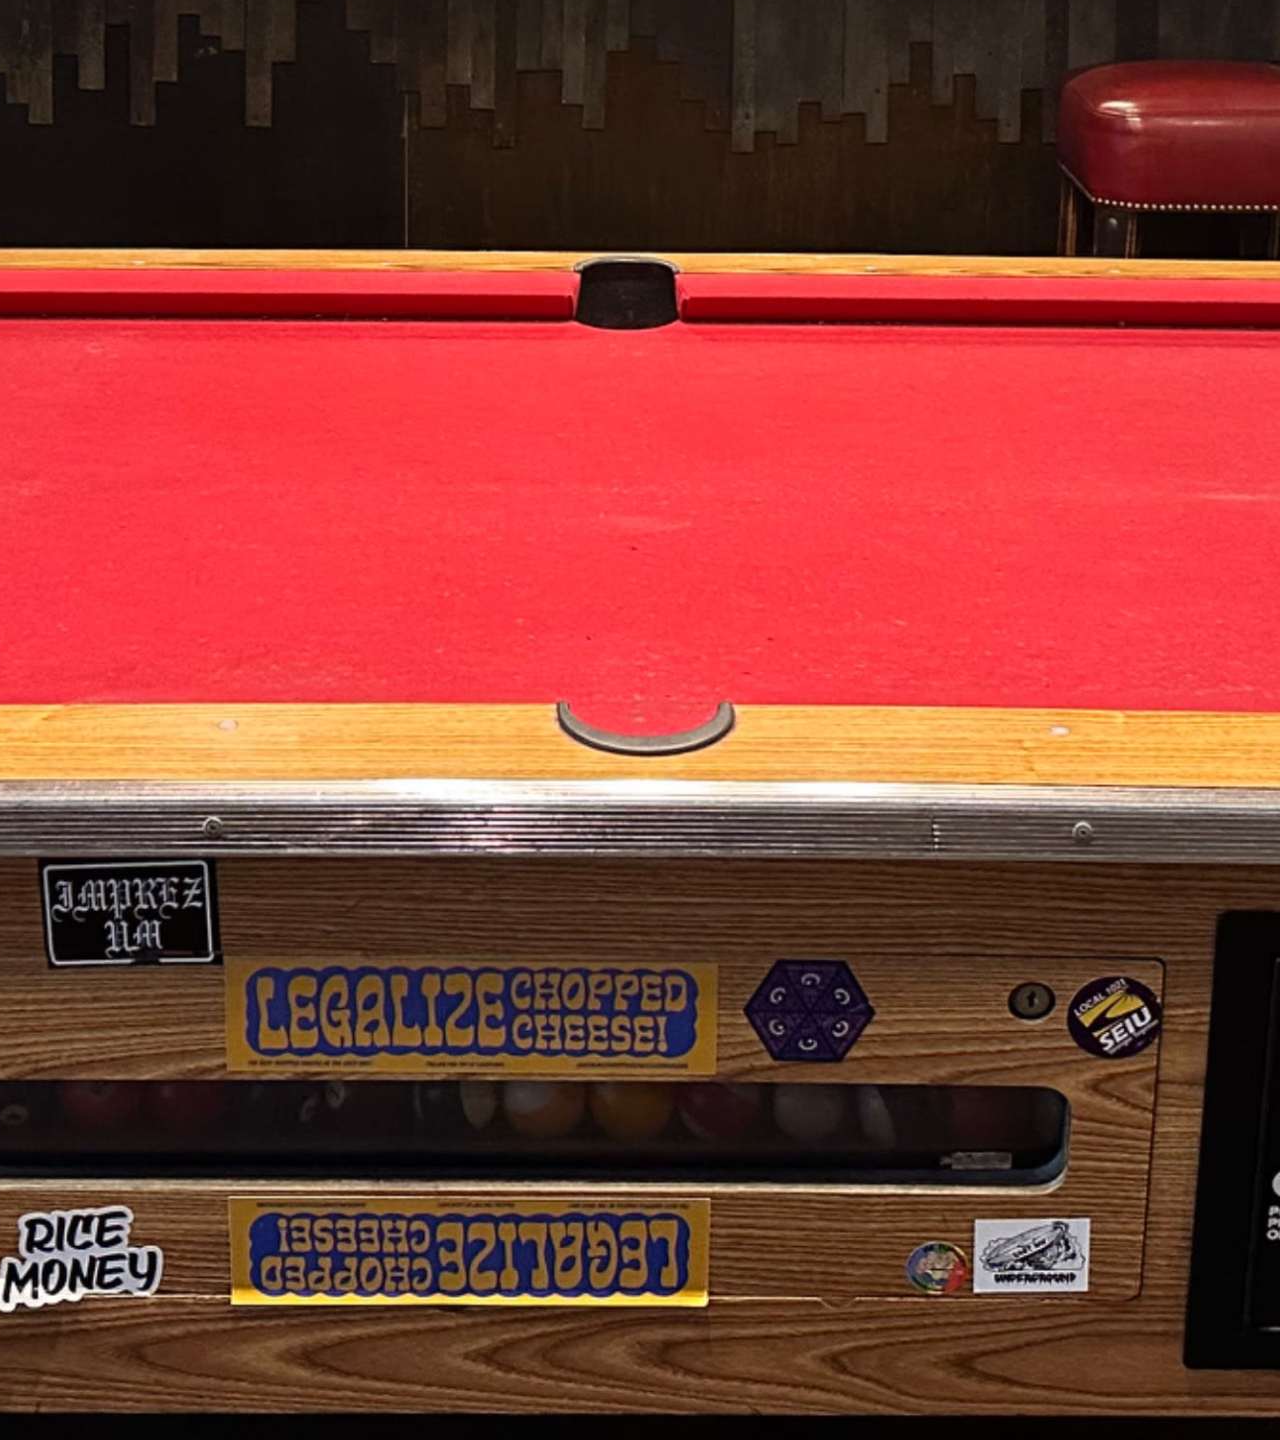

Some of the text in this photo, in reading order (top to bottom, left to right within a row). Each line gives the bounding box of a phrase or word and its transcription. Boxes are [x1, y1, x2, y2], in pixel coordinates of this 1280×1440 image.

[255, 972, 506, 1051] LEGALIZE
[510, 972, 688, 1012] CHOPPED
[1072, 991, 1106, 1018] LOCAL
[511, 1013, 669, 1053] CHEESE!
[1098, 1006, 1153, 1052] SEIU
[24, 1210, 128, 1254] RICE
[277, 1217, 433, 1253] CHEESE!
[1, 1250, 159, 1303] MONEY
[260, 1219, 680, 1292] CHOPPED LEGALIZE
